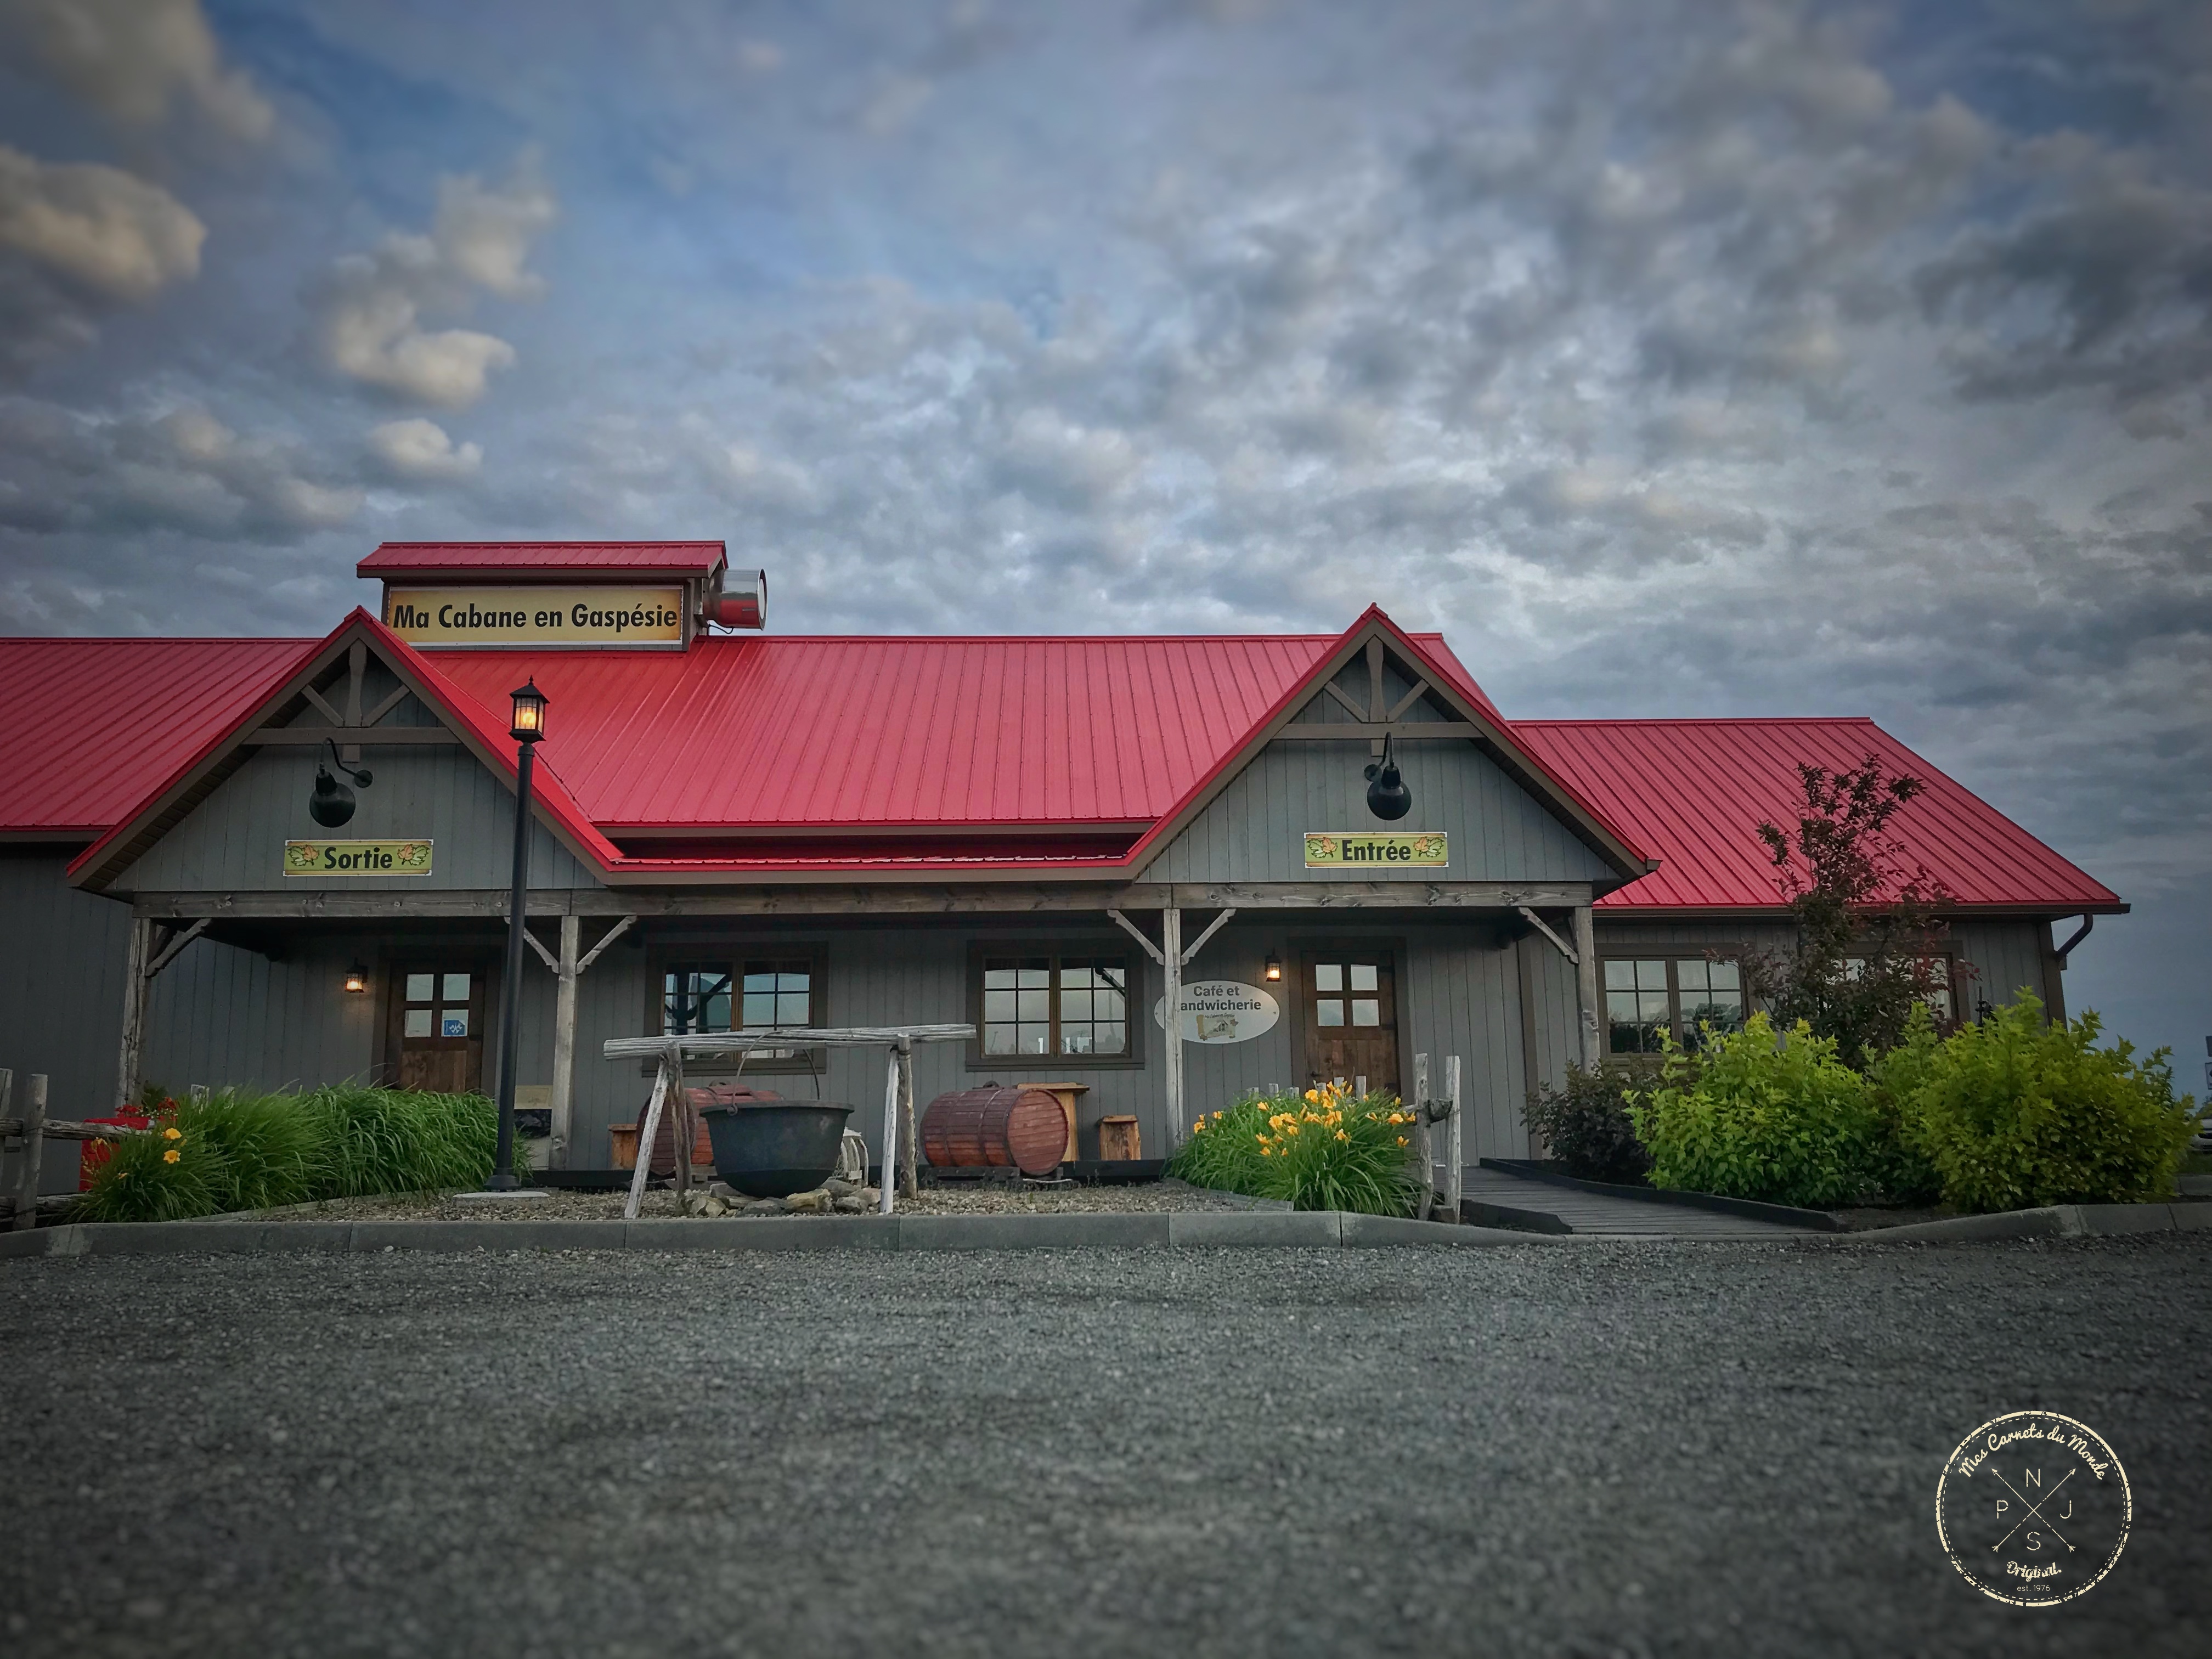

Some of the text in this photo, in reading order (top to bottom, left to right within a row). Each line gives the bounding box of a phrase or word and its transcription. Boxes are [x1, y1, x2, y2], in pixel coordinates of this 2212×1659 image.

[393, 603, 678, 633] Ma Cabane en Gaspésie
[324, 847, 393, 869] Sortie
[1342, 839, 1411, 861] Entrée
[1193, 985, 1240, 996] Café et
[1181, 998, 1261, 1011] andwicherie
